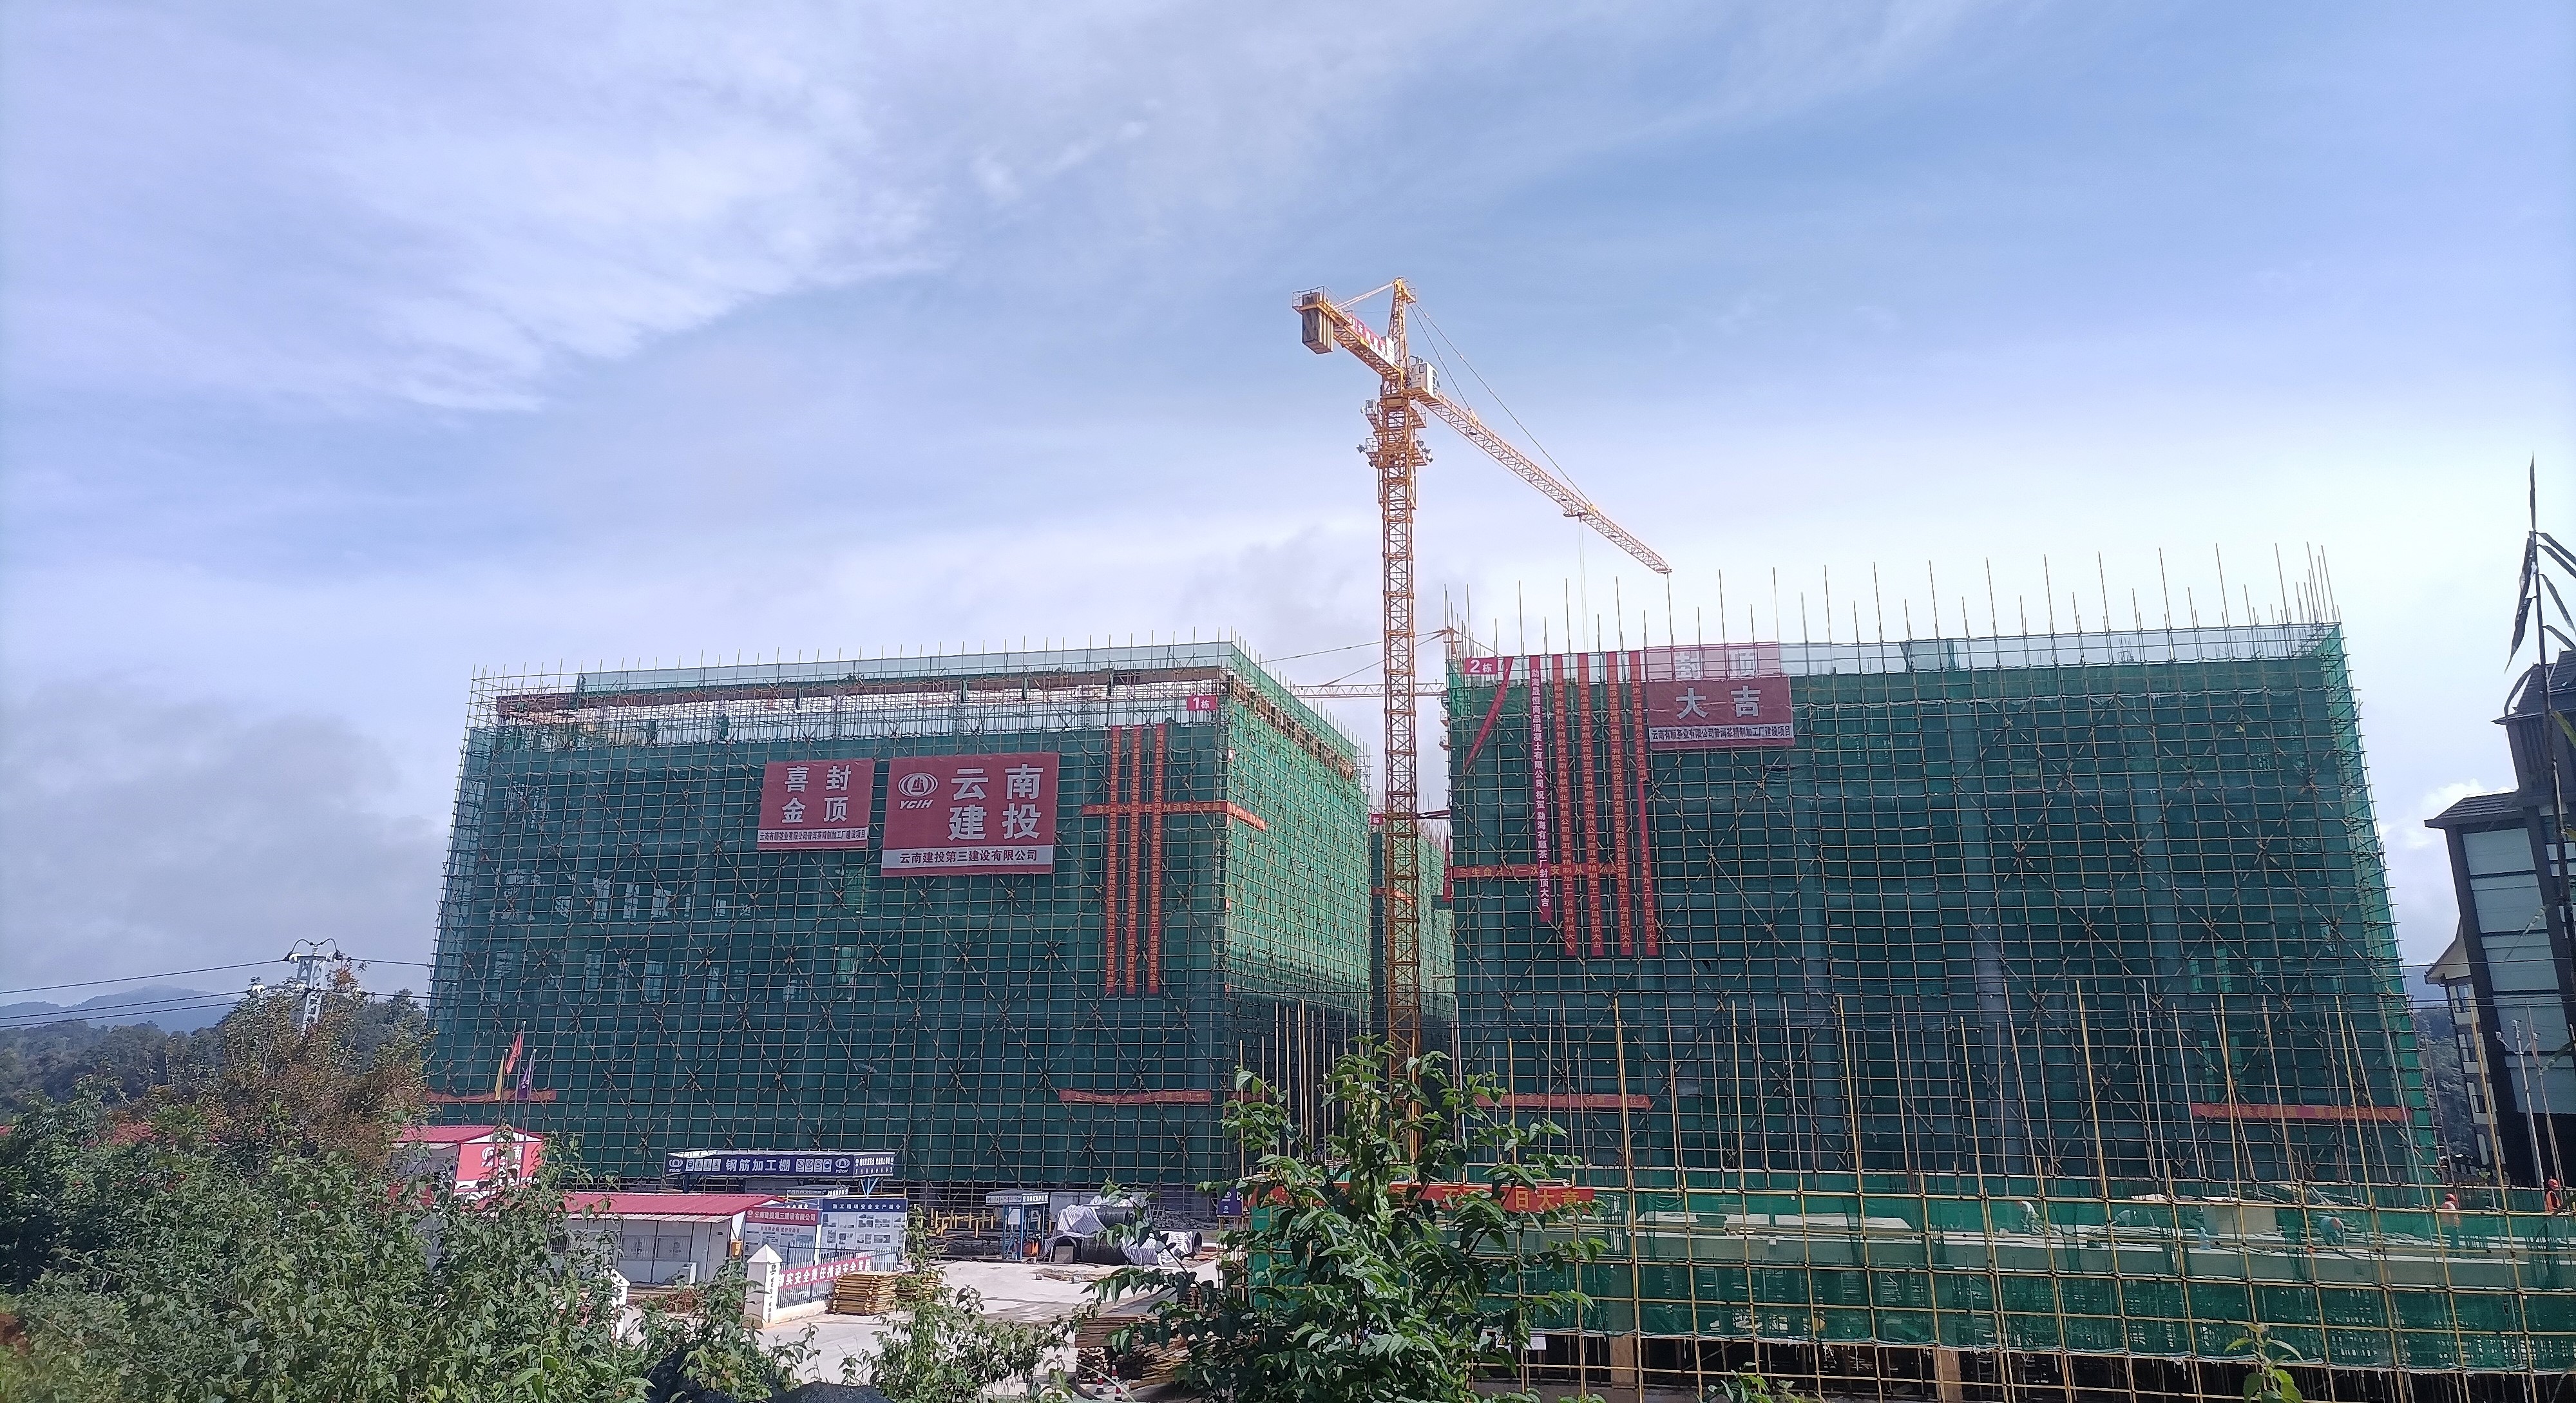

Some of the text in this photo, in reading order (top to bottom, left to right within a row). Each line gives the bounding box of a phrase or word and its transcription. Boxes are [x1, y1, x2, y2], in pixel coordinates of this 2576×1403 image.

[1469, 659, 1493, 673] 2栋
[1192, 696, 1210, 709] 1栋
[1675, 685, 1761, 720] 大吉
[785, 765, 852, 792] 喜封
[950, 763, 1044, 800] 云南
[781, 796, 849, 824] 金顶
[899, 799, 933, 809] YCIH
[948, 803, 1042, 841] 建投
[899, 849, 1038, 864] 云南建投第三建设有限公司
[725, 1158, 791, 1172] 钢筋加工棚
